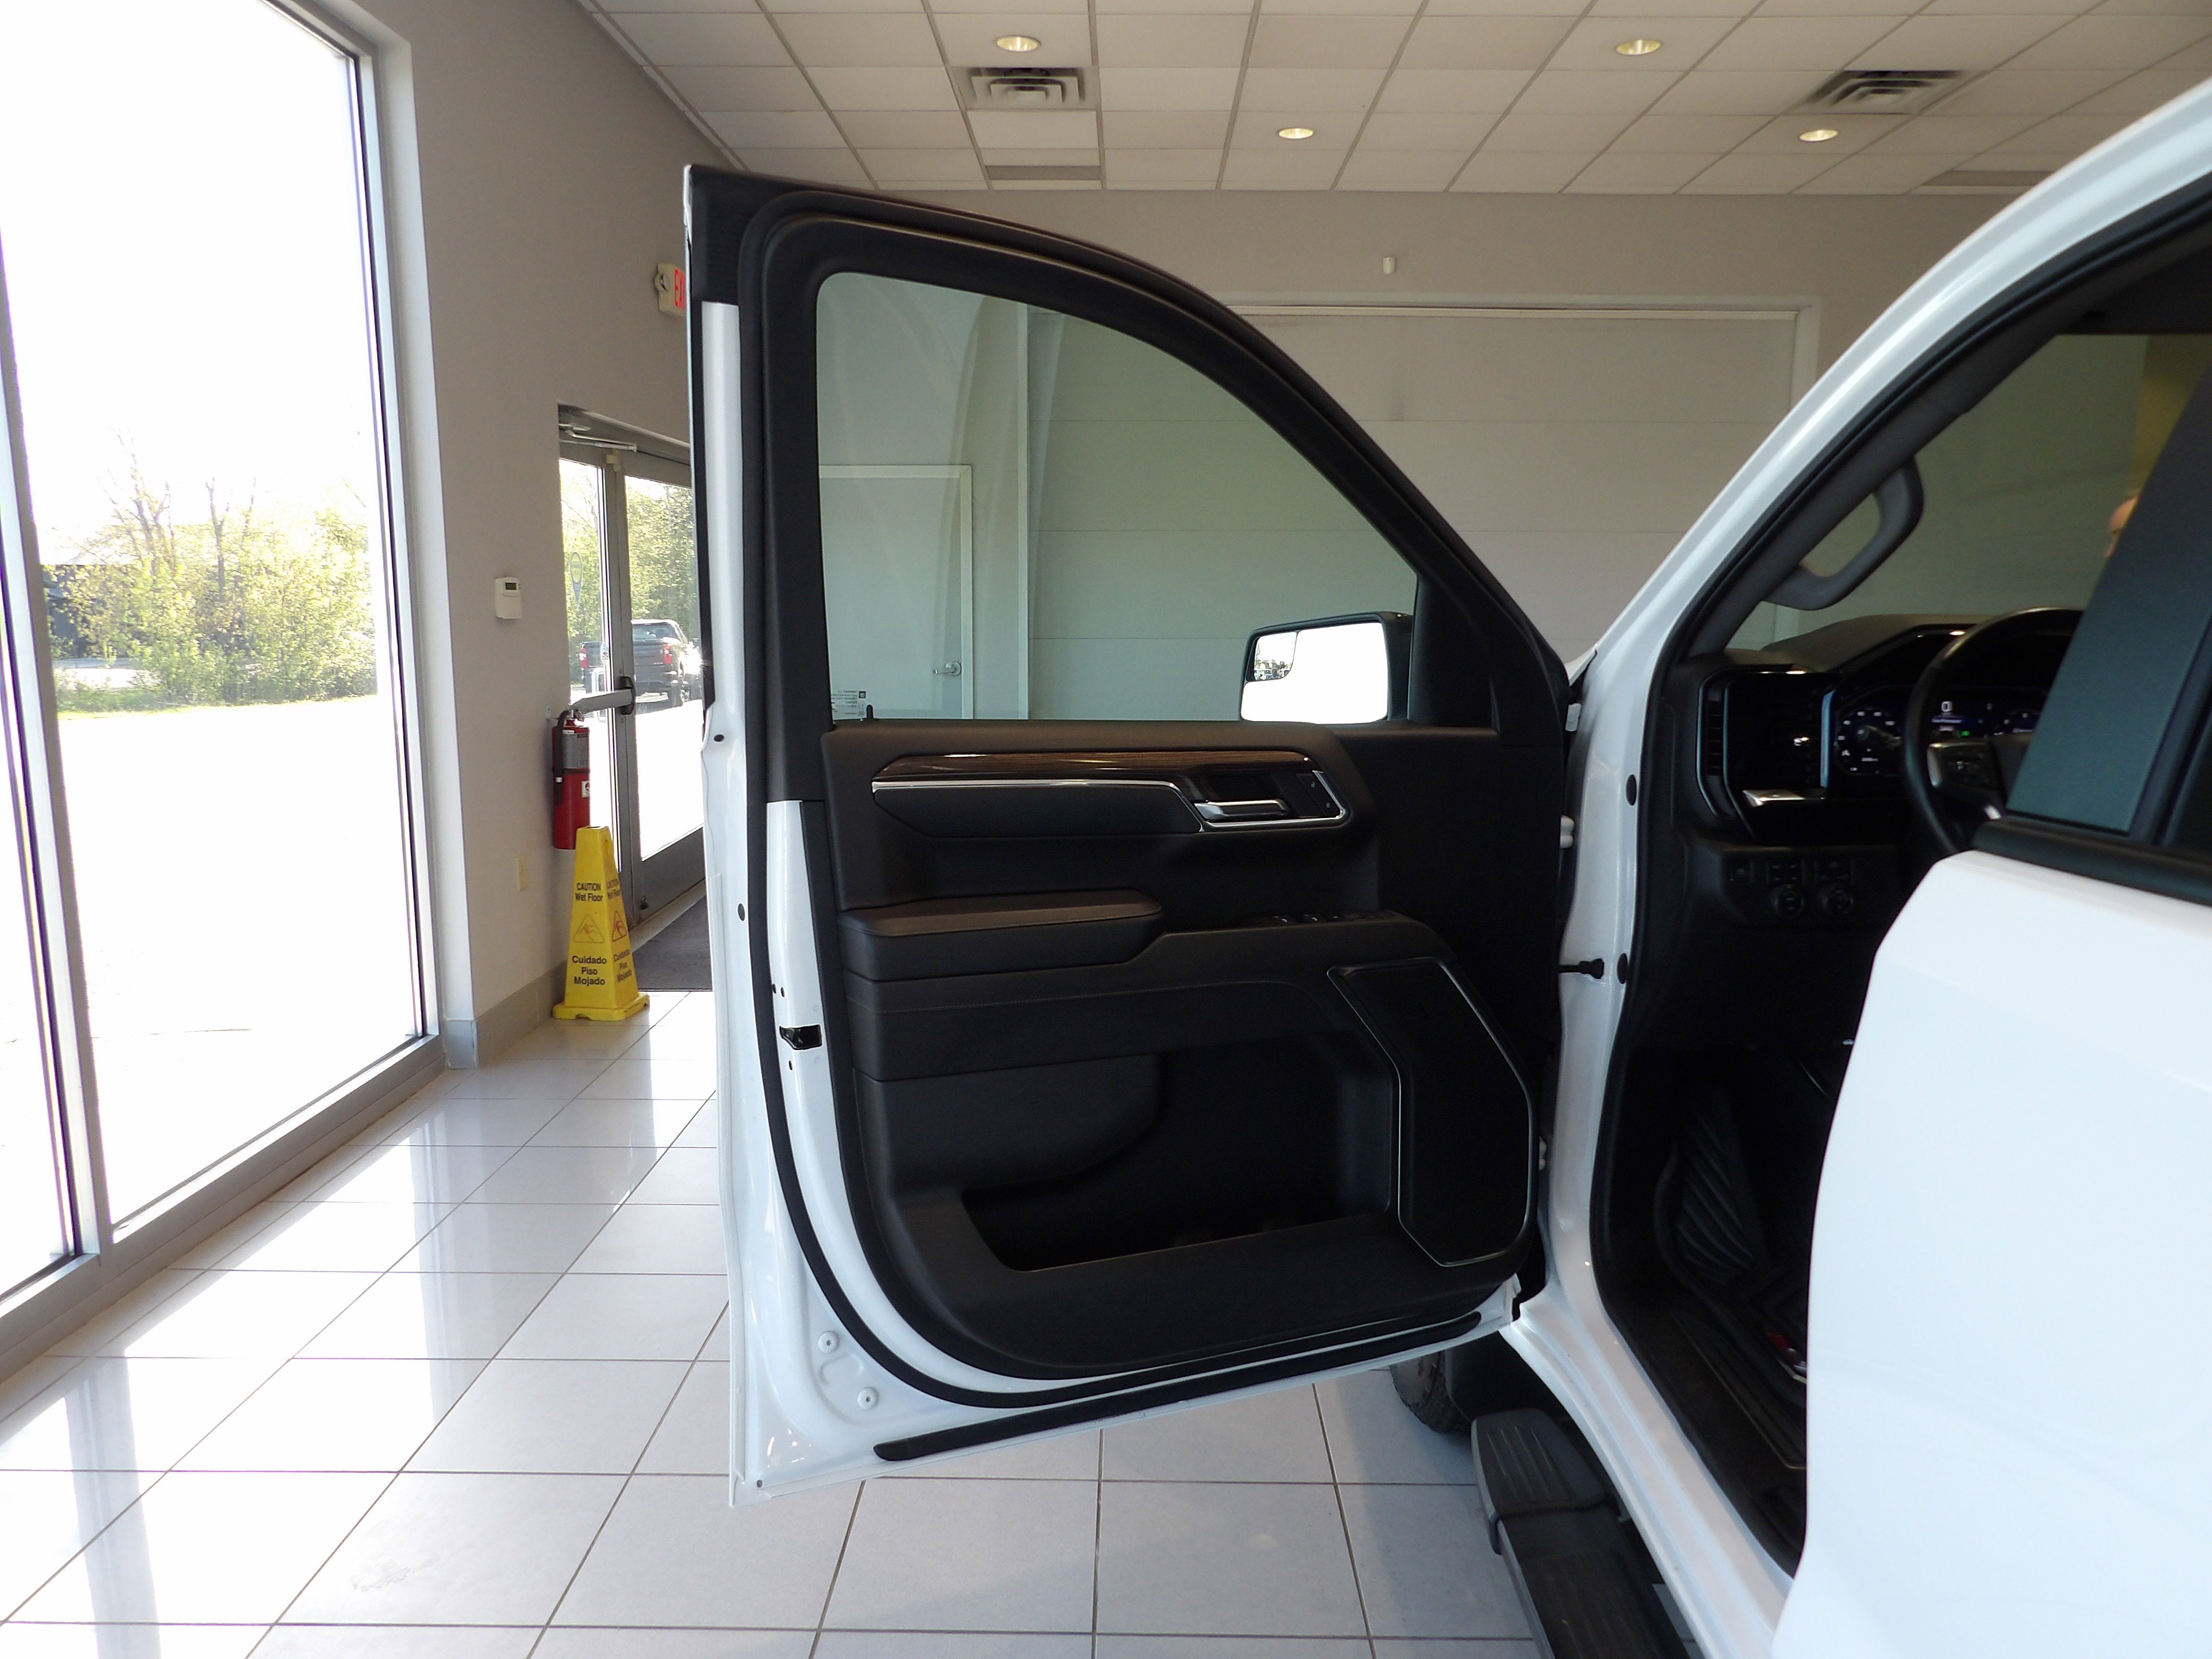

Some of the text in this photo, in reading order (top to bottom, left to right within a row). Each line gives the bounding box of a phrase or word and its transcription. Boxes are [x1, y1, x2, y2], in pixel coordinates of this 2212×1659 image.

[577, 882, 601, 891] CAUTION
[575, 893, 586, 901] Wet
[588, 893, 603, 902] Floor
[572, 955, 607, 964] Cuidado
[581, 966, 598, 975] Piso
[574, 976, 605, 986] Mojado
